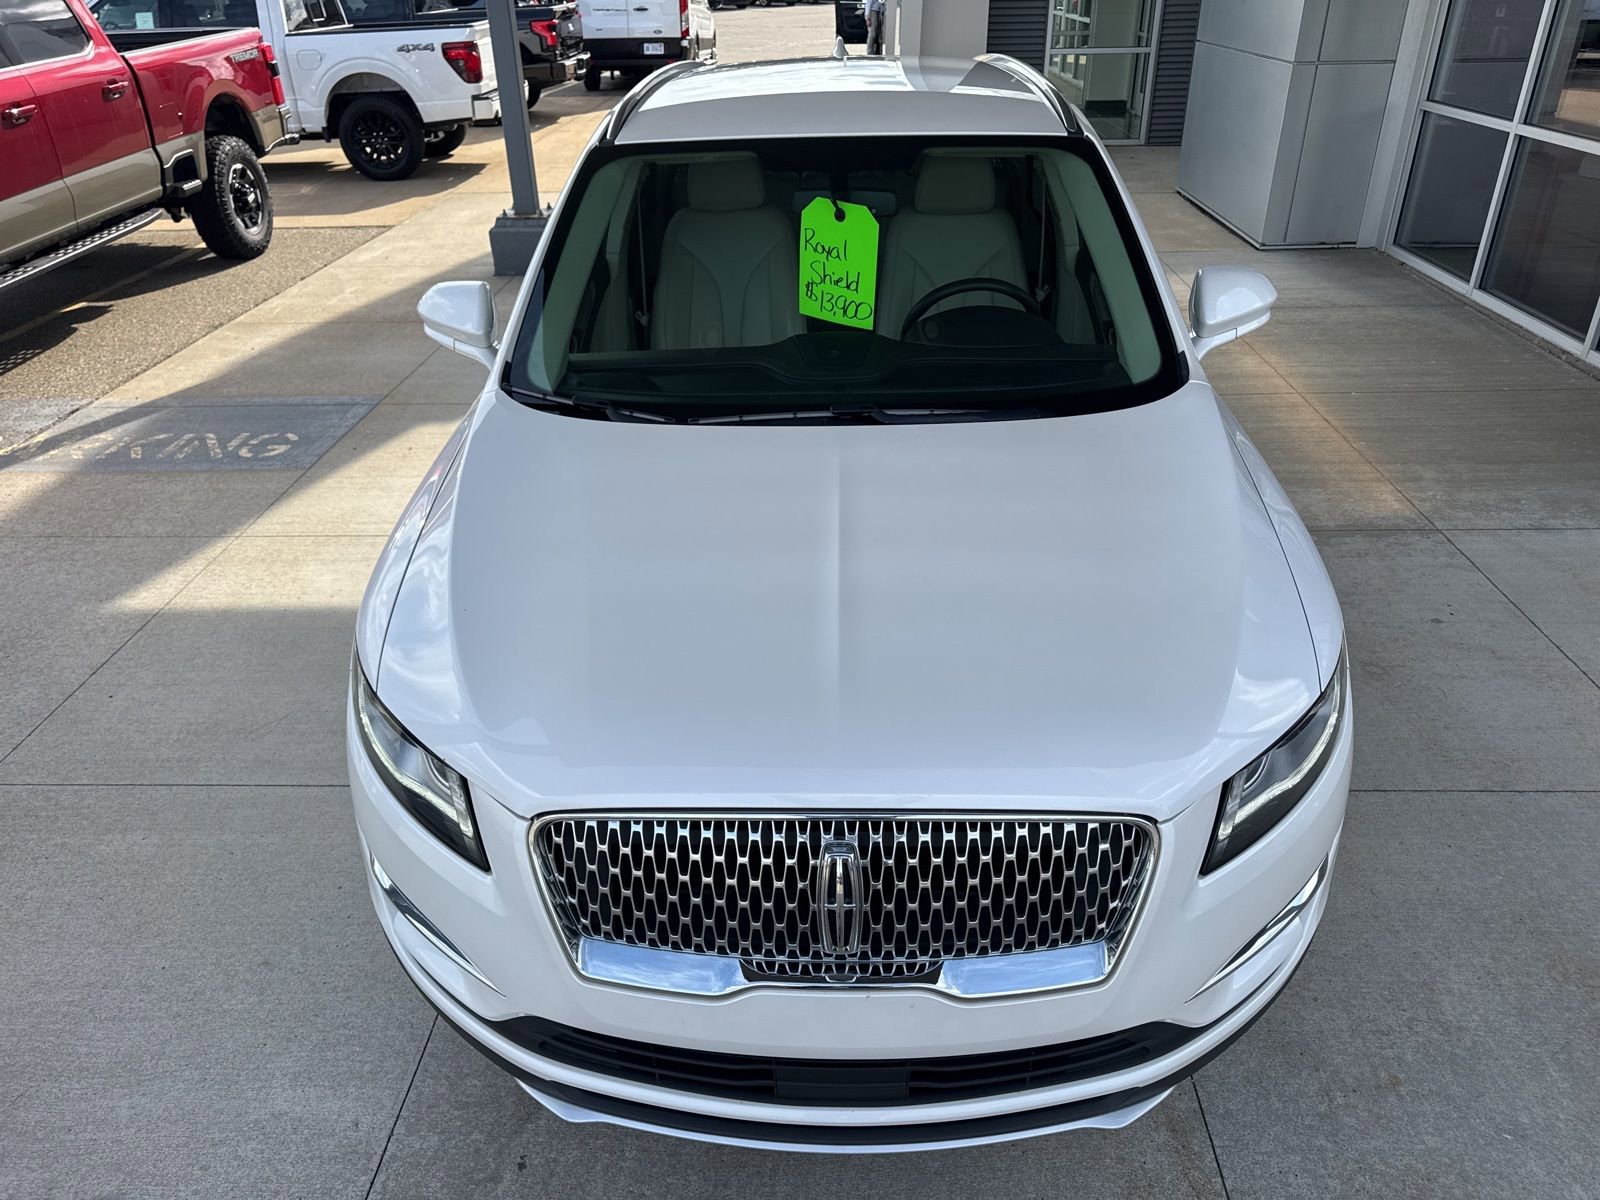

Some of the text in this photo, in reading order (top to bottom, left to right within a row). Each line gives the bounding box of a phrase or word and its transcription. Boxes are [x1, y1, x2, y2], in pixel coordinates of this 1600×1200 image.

[804, 228, 848, 261] Royal
[810, 260, 860, 294] Shield
[805, 278, 873, 320] $13,900
